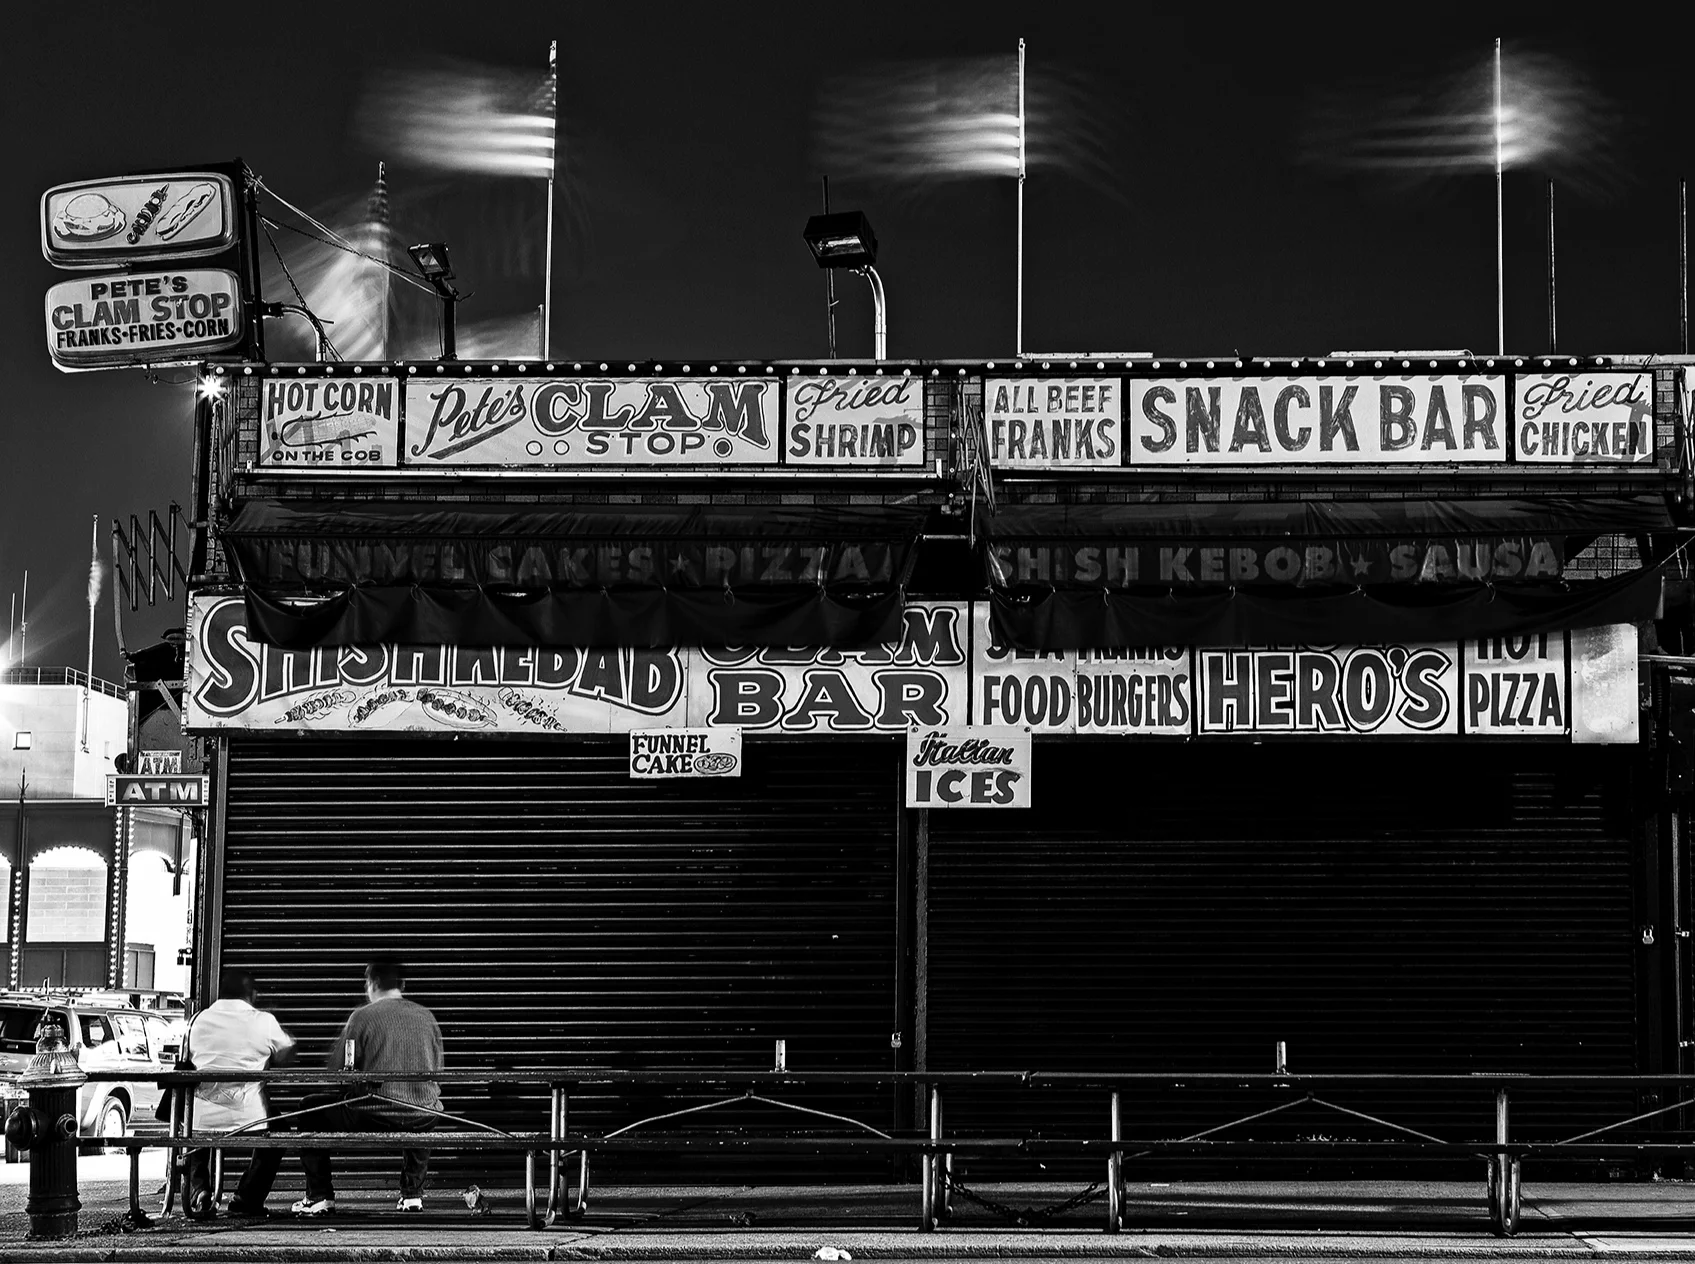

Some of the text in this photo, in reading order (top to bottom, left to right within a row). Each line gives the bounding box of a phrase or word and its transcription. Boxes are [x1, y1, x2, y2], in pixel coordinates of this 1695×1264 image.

[90, 275, 188, 300] PETE'S
[52, 292, 231, 330] CLAM STOP
[57, 318, 229, 348] FRANKS FRIES CORN
[267, 382, 393, 421] HOT CORN
[793, 377, 911, 422] Fried
[994, 385, 1113, 414] ALL BEEF
[1522, 374, 1645, 420] Fried
[411, 380, 771, 458] Pete's CLAM
[1140, 384, 1500, 453] SNACK BAR
[272, 450, 381, 462] ON THE COB
[585, 430, 706, 455] STOP
[789, 423, 917, 458] SHRIMP
[991, 419, 1116, 460] FRANKS
[1520, 421, 1647, 457] CHICKEN
[488, 545, 655, 584] CAKES
[704, 545, 871, 582] PIZZA
[991, 542, 1559, 583] SHISH KEBOB SAUSA
[706, 668, 949, 730] BAR
[983, 674, 1071, 726] FOOD
[1077, 673, 1190, 727] BURGERS
[1201, 645, 1453, 732] HERO'S
[1468, 673, 1563, 727] PIZZA
[632, 734, 711, 754] FUNNEL
[913, 731, 1015, 766] Italian
[632, 754, 693, 774] CAKE
[121, 782, 198, 800] ATM
[916, 769, 1021, 804] ICES
